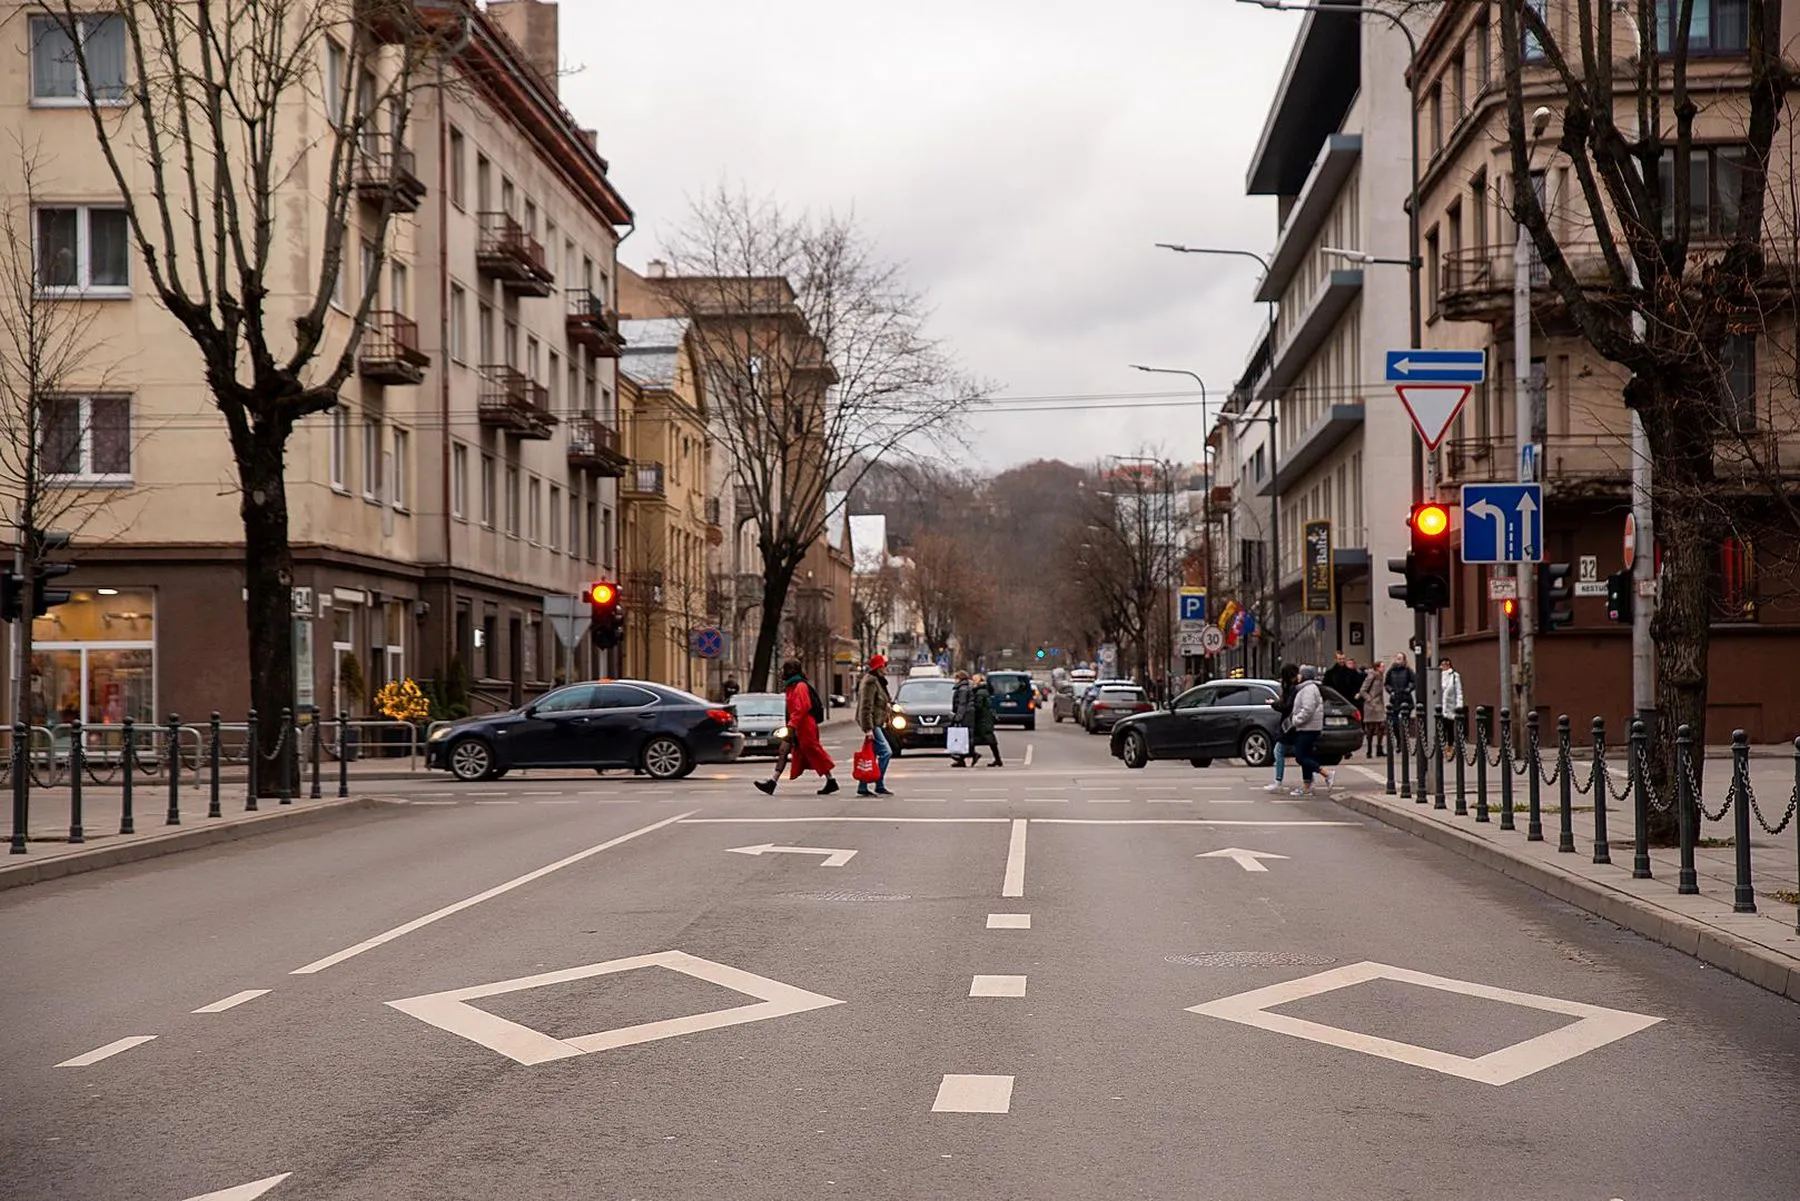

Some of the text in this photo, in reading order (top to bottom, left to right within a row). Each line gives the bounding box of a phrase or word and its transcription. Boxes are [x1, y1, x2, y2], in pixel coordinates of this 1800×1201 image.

[1582, 559, 1595, 579] 32
[1187, 598, 1200, 617] P
[1206, 633, 1220, 645] 30
